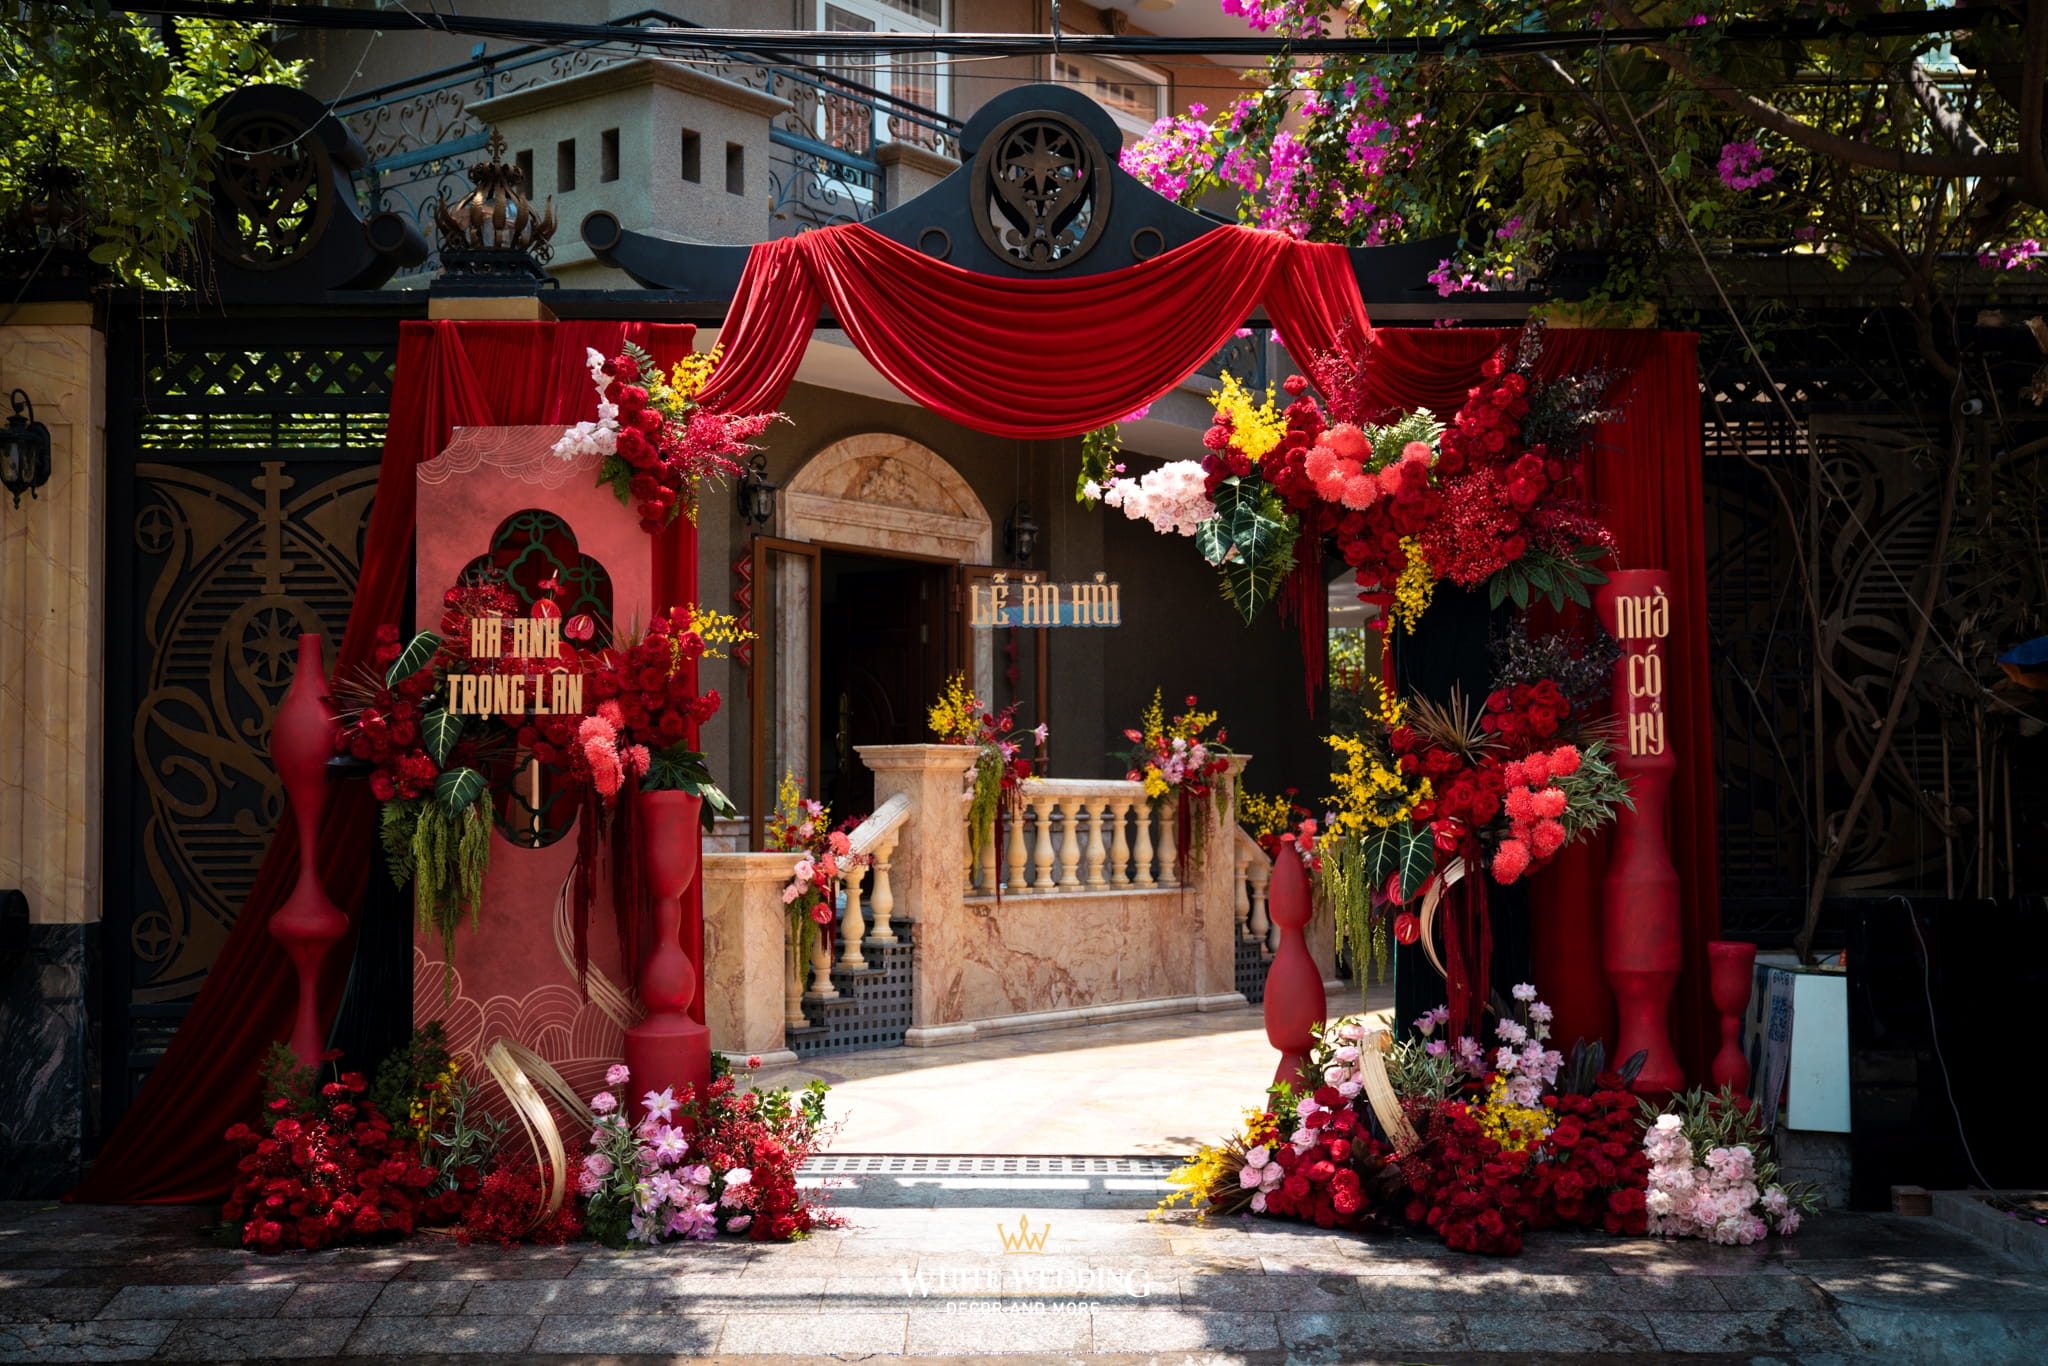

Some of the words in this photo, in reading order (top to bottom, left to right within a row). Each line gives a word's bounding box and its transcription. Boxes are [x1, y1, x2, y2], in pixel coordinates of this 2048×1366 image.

[970, 571, 1010, 625] LỄ
[1022, 574, 1061, 625] ĂN
[1071, 572, 1120, 625] HỎI
[471, 609, 504, 658] HÀ
[513, 617, 560, 658] ANH
[447, 674, 525, 721] TRỌNG
[535, 666, 583, 715] LÂN
[1628, 644, 1663, 698] CÓ
